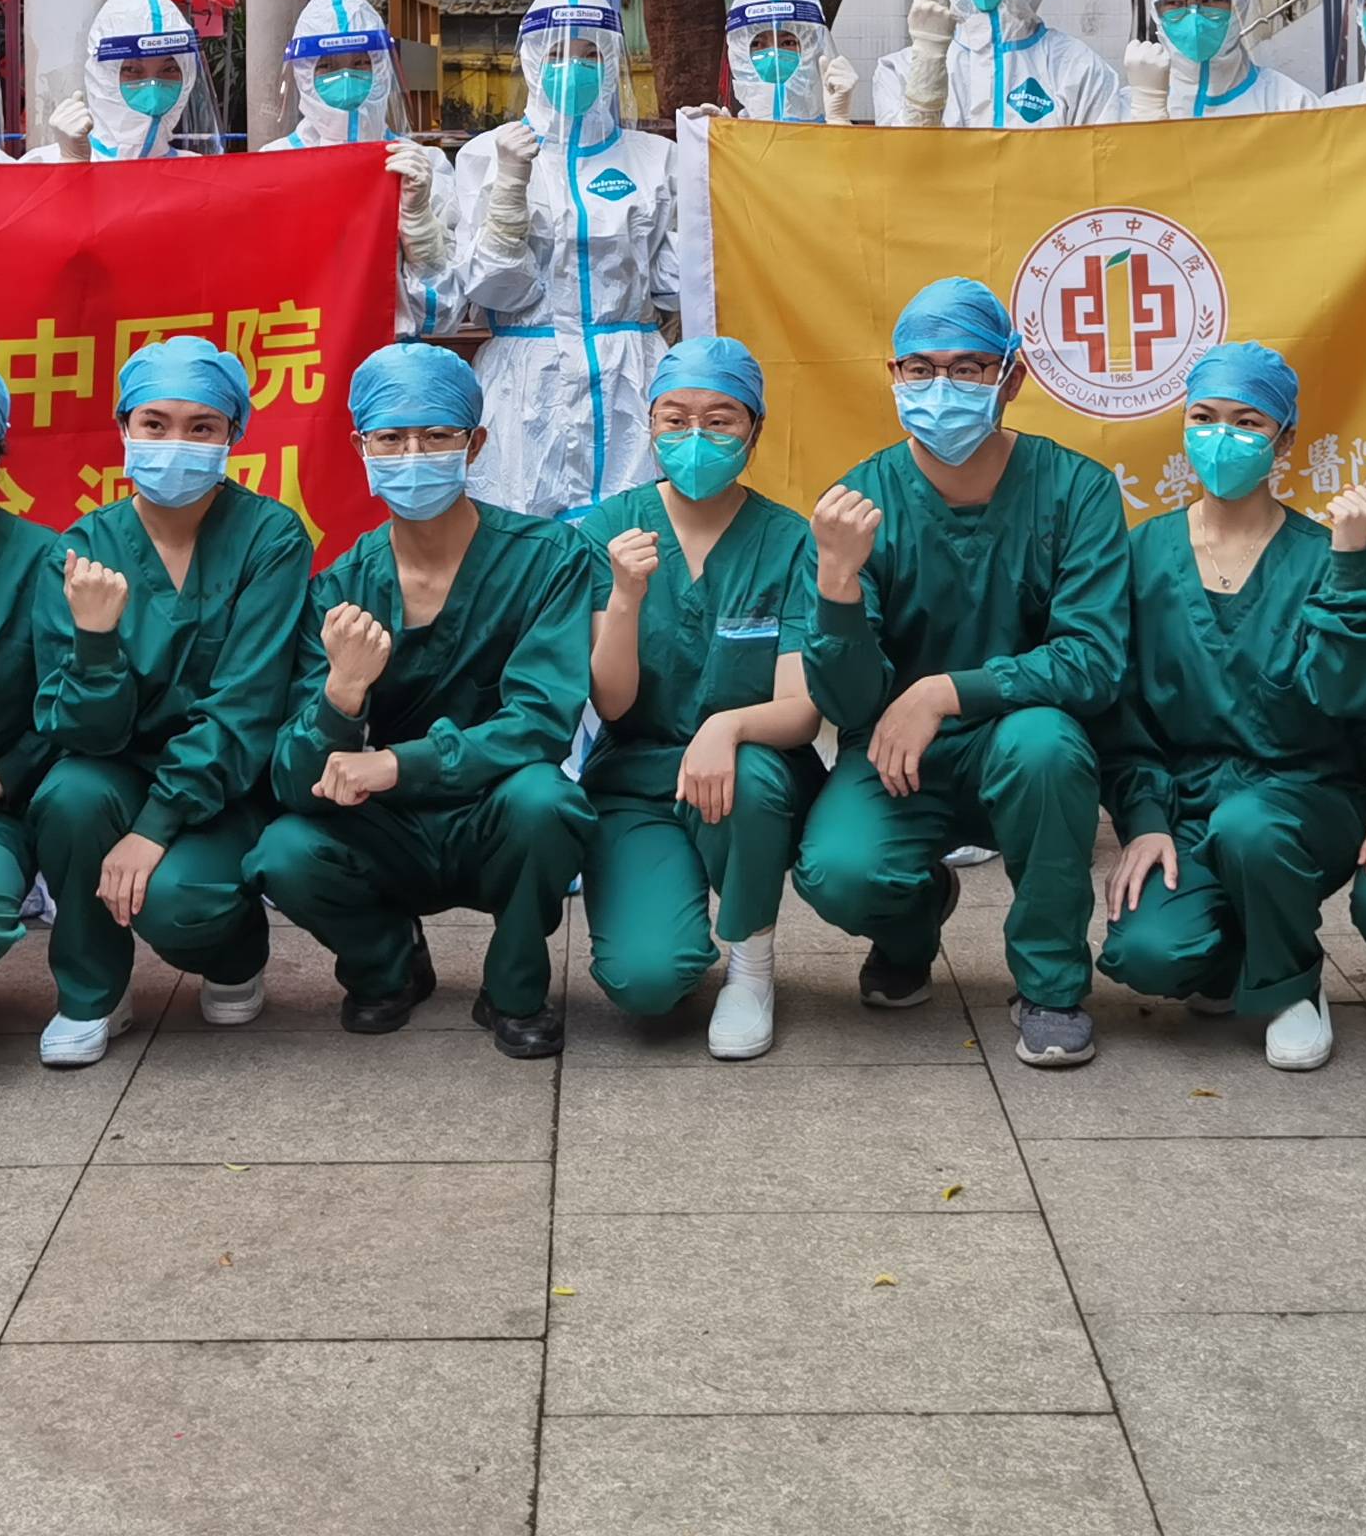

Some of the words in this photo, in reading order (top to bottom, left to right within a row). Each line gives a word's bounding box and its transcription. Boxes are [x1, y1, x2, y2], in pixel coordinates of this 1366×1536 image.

[1030, 217, 1206, 283] 东莞市中医院
[1032, 348, 1110, 409] DONGGUAN
[1113, 393, 1148, 409] TCM
[1149, 344, 1210, 402] HOSPITAL
[1109, 373, 1134, 383] 1965
